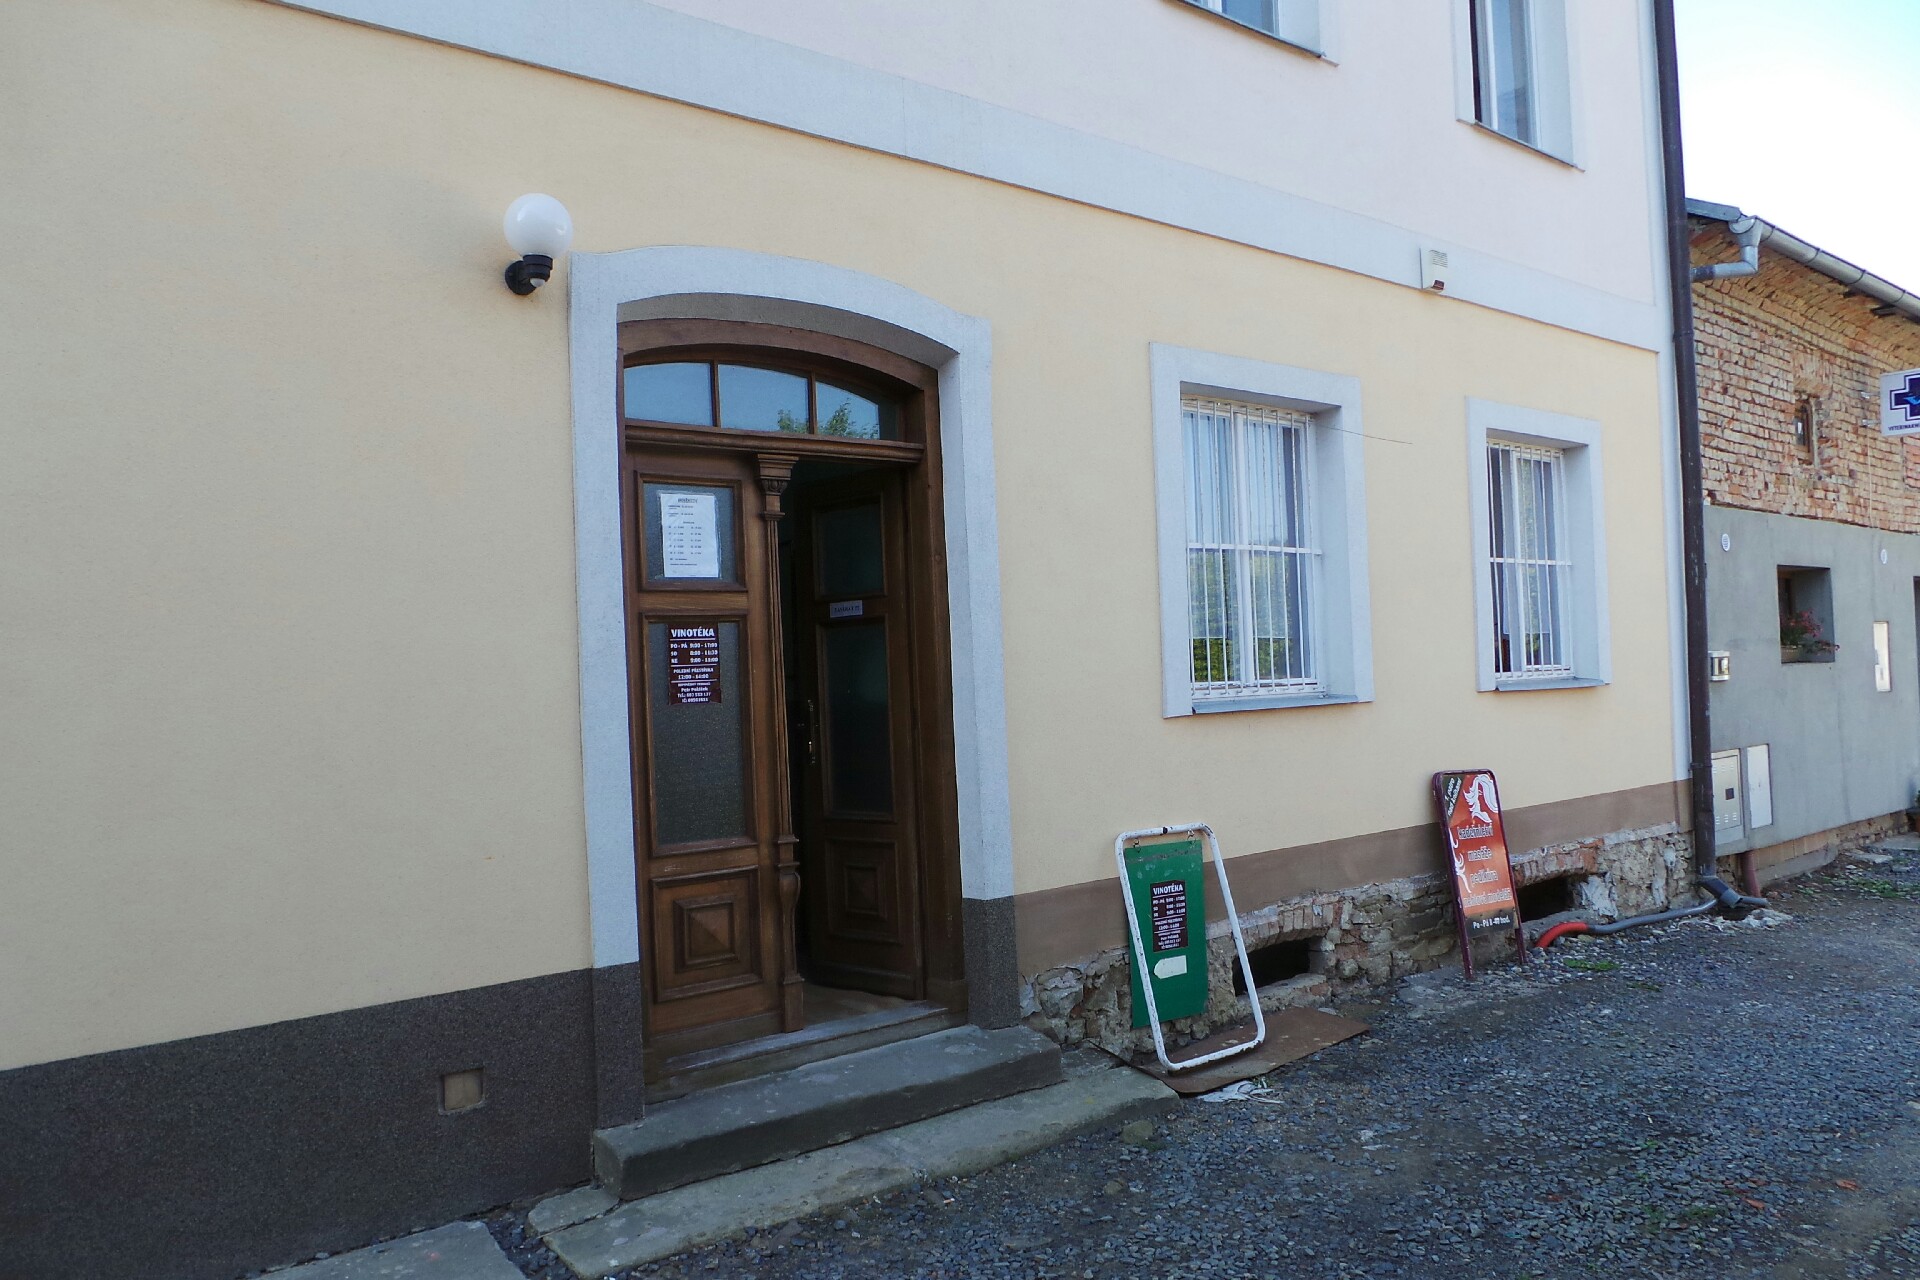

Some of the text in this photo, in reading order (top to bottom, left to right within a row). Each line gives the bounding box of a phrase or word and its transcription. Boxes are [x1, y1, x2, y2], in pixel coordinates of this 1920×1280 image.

[671, 626, 715, 637] VINOTÉKA
[1457, 823, 1494, 840] kadeřnictví
[1467, 846, 1493, 861] masáže
[1153, 883, 1183, 895] VINOTÉKA
